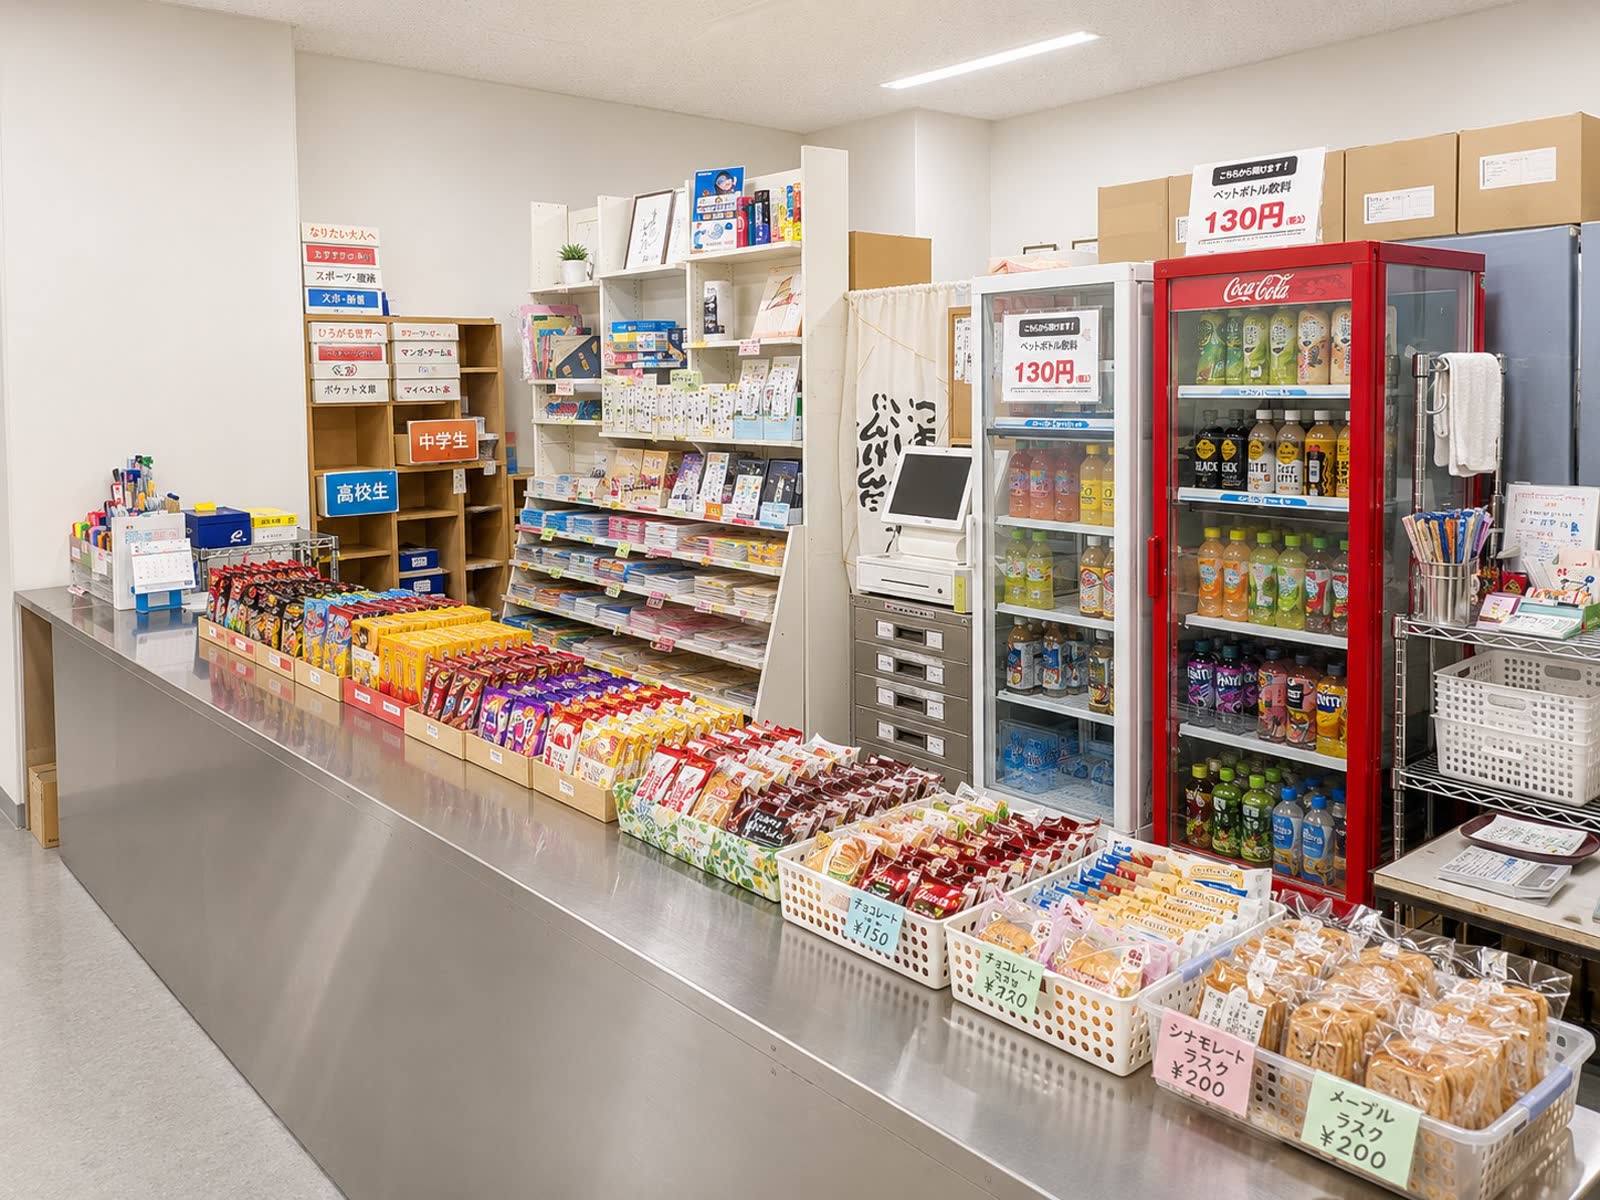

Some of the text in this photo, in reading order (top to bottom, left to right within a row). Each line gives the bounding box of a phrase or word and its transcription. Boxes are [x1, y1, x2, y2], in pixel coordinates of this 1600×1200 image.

[1213, 180, 1291, 200] ペットボトル飲料
[1205, 201, 1285, 234] 130円
[309, 227, 376, 240] なりたい大人へ
[1223, 273, 1295, 303] Coca-Cola
[318, 328, 382, 339] ひろがる世界へ
[1020, 340, 1078, 351] ペットボトル飲料
[1015, 359, 1074, 384] 130円
[419, 430, 469, 451] 中学生
[336, 482, 390, 504] 高校生
[854, 897, 898, 924] チョコレート
[853, 919, 889, 946] ¥150
[985, 952, 1036, 982] チョコレート
[1169, 1023, 1245, 1064] シナモレート
[1184, 1048, 1229, 1077] ラスク
[1171, 1060, 1225, 1098] ¥200
[1337, 1112, 1383, 1143] ラスク
[1320, 1125, 1387, 1170] ¥200
